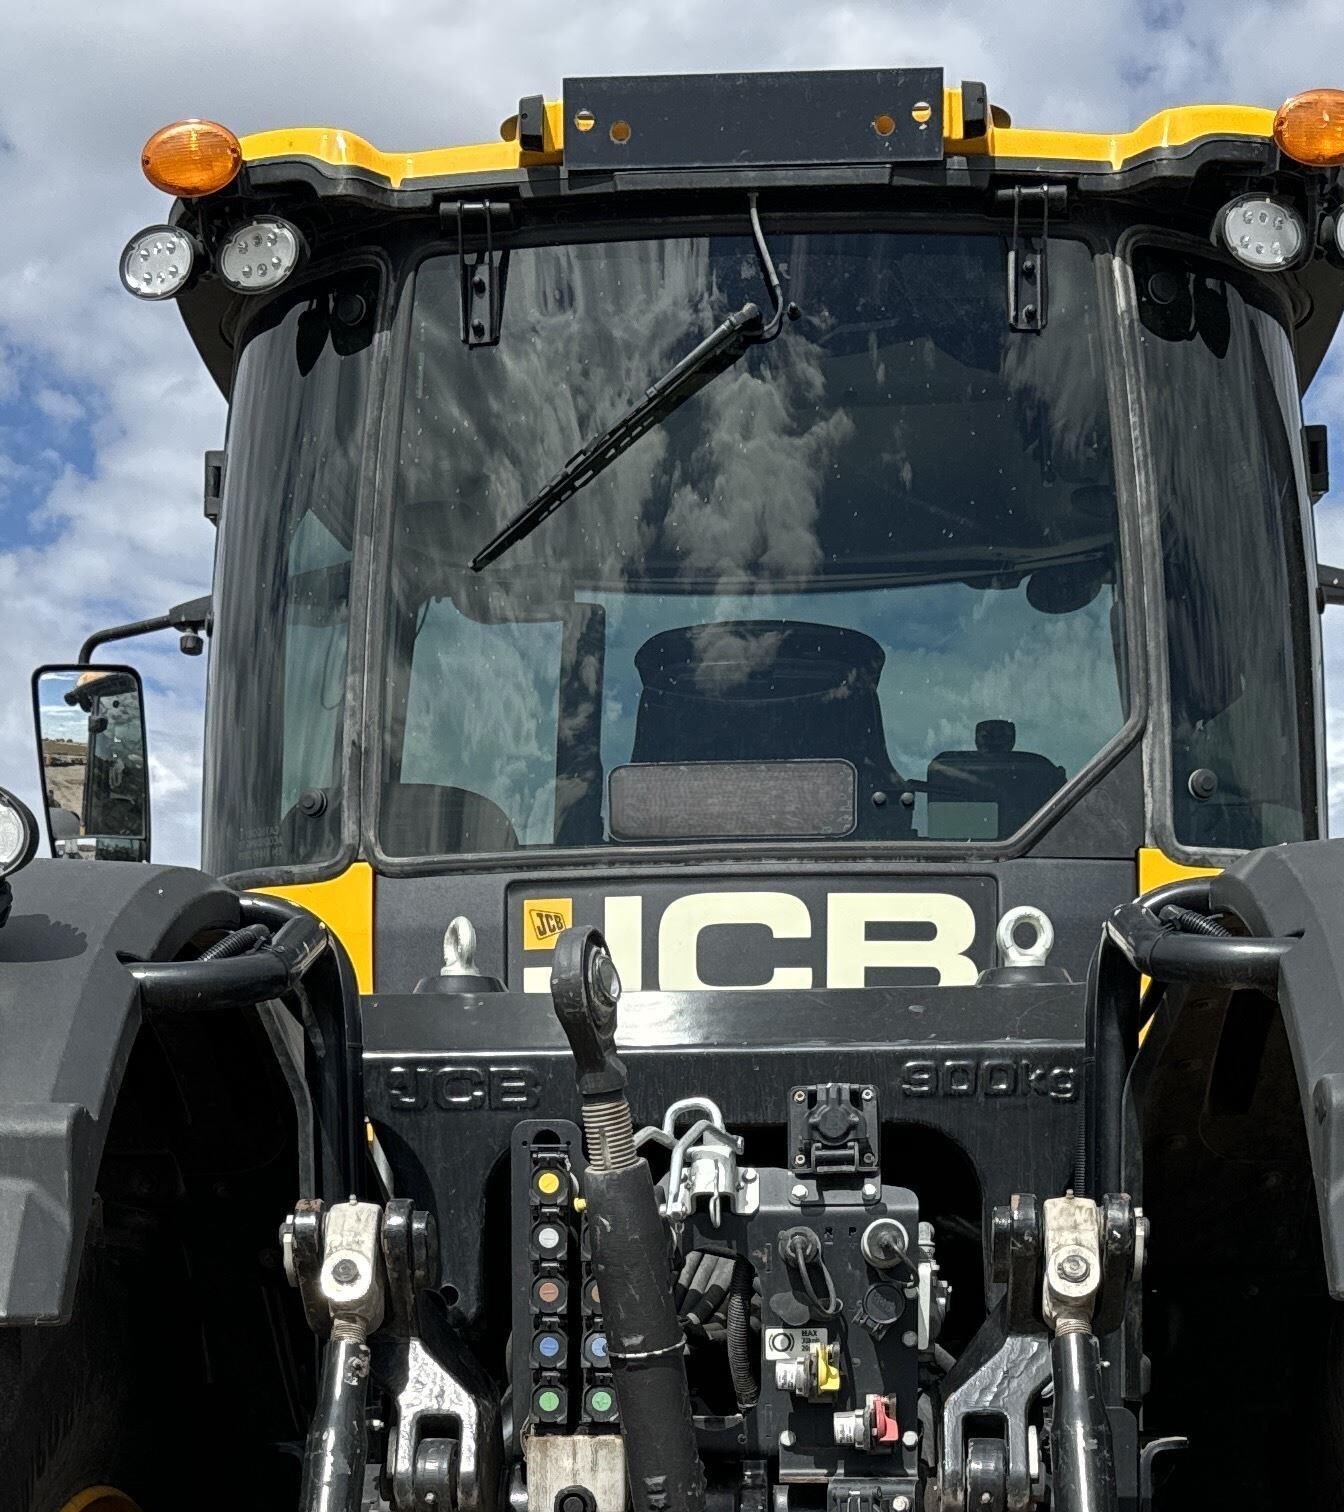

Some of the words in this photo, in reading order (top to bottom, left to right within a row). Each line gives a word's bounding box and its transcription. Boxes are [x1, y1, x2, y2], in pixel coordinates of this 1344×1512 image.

[524, 891, 977, 991] JCB
[536, 912, 563, 937] JCB
[388, 1066, 540, 1111] JCB
[902, 1060, 1077, 1100] 900kg
